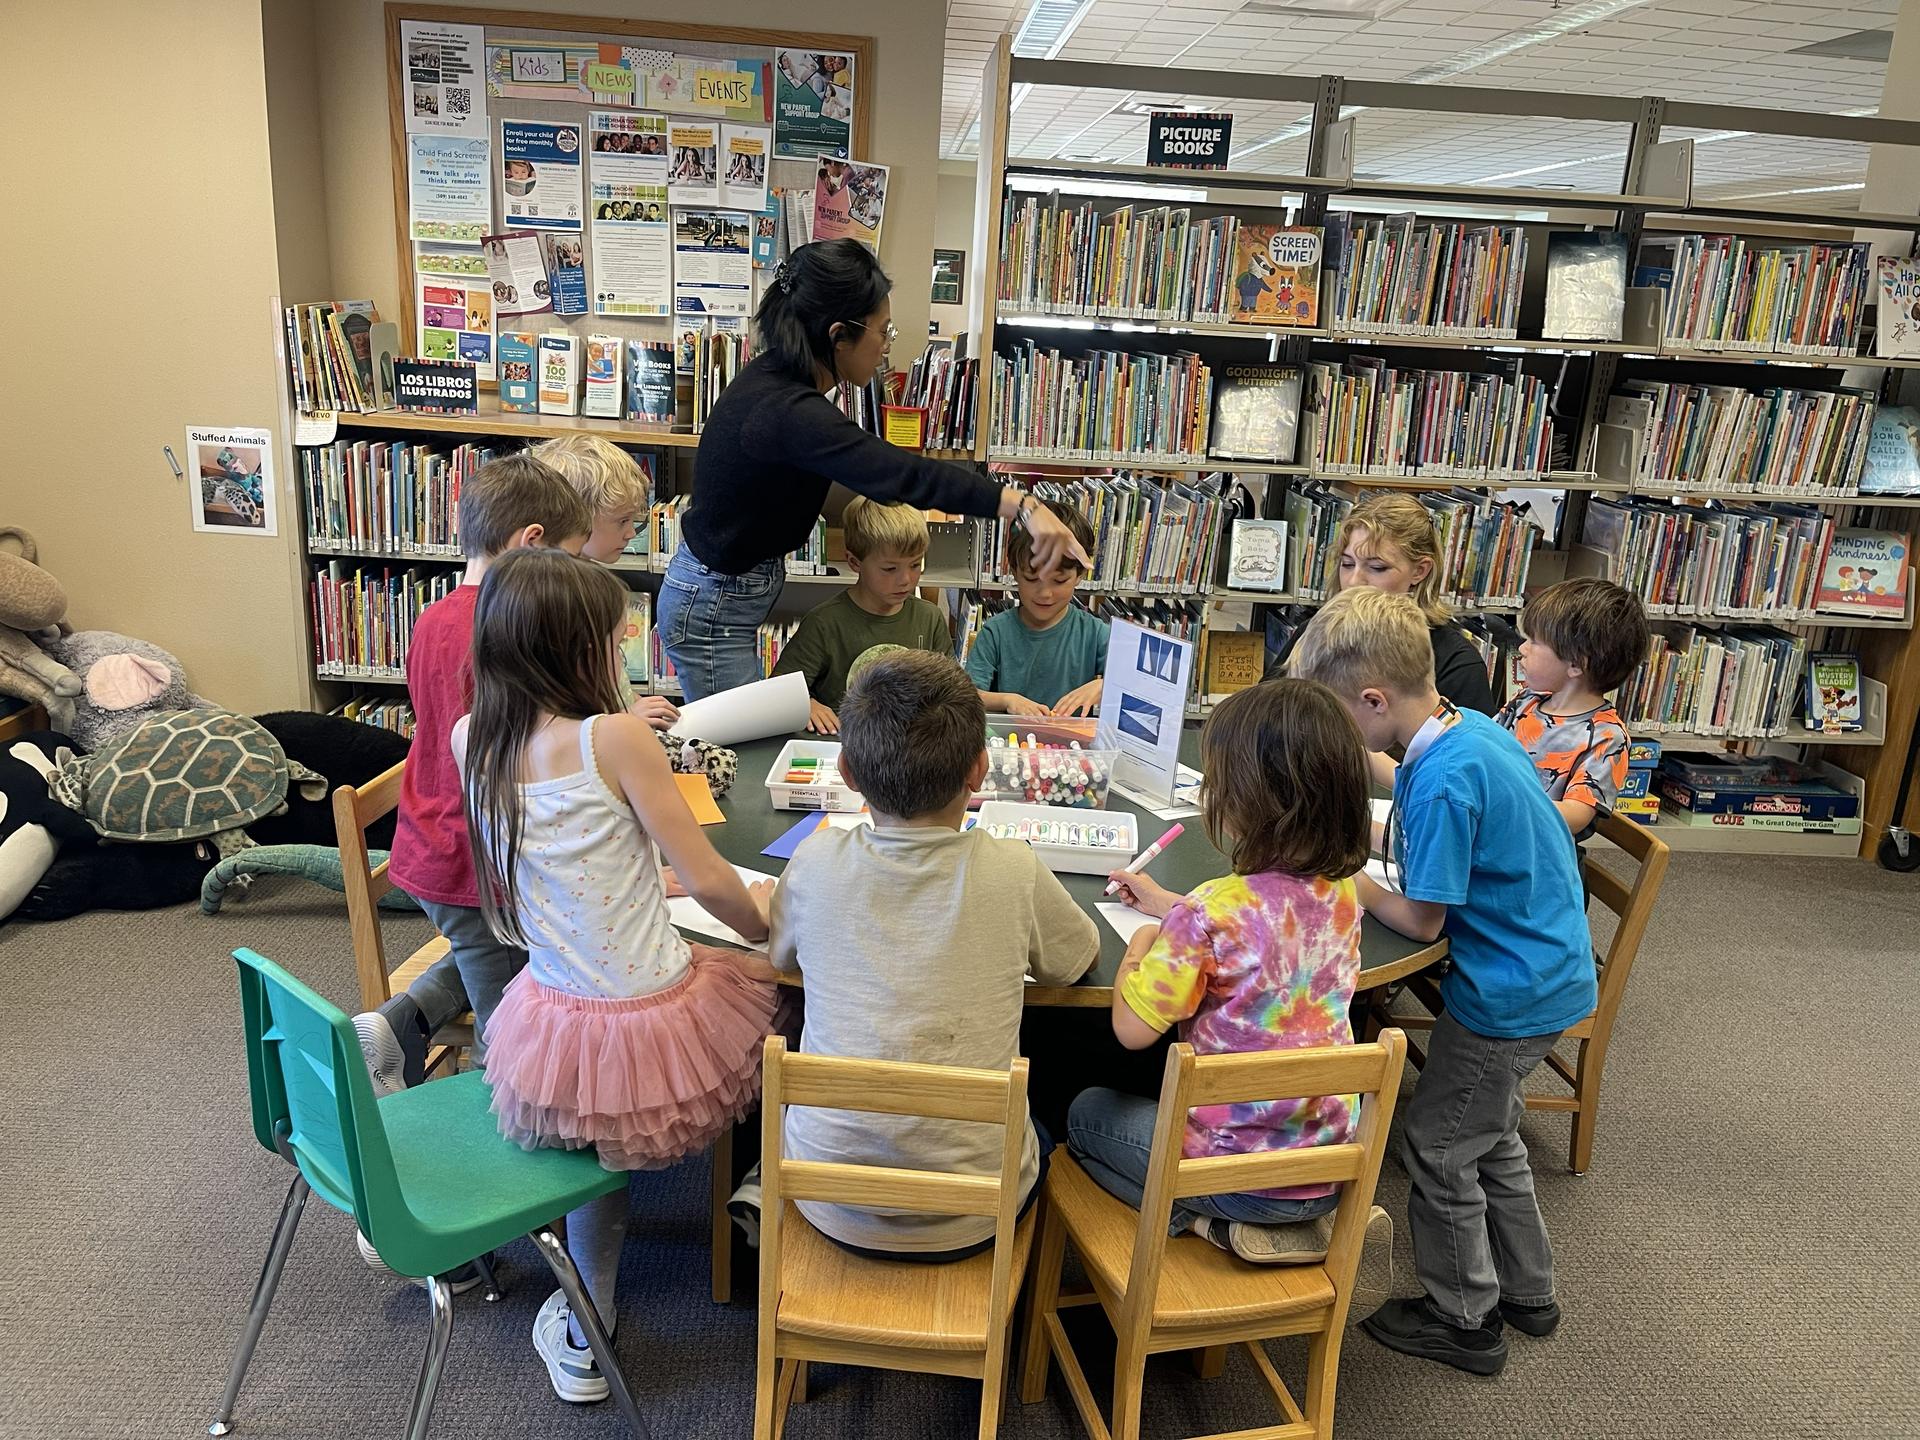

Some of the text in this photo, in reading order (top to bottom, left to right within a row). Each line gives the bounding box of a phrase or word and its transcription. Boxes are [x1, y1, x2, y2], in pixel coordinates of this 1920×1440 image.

[518, 56, 550, 76] Kids
[595, 71, 632, 87] NEWS
[700, 78, 748, 103] EVENTS
[780, 102, 811, 111] NEW PARENT
[1160, 126, 1222, 141] PICTURE
[529, 139, 553, 147] monthly
[1164, 141, 1214, 155] BOOKS
[417, 149, 487, 161] Child Find Screening
[1272, 236, 1317, 249] SCREEN
[1273, 249, 1313, 263] TIME!
[1895, 283, 1909, 297] All
[546, 366, 566, 376] 100
[649, 361, 671, 369] BOOKS
[400, 374, 472, 389] LOS LIBROS
[1238, 378, 1284, 387] BUTTERFLY
[401, 386, 472, 399] ILUSTRADOS
[192, 432, 266, 445] Stuffed Animals
[1873, 432, 1901, 440] SONG
[1871, 446, 1906, 455] CALLED
[1834, 536, 1886, 550] FINDING
[1828, 547, 1890, 560] Kindness
[1754, 803, 1800, 812] MONOLY
[1712, 815, 1744, 826] CLUE
